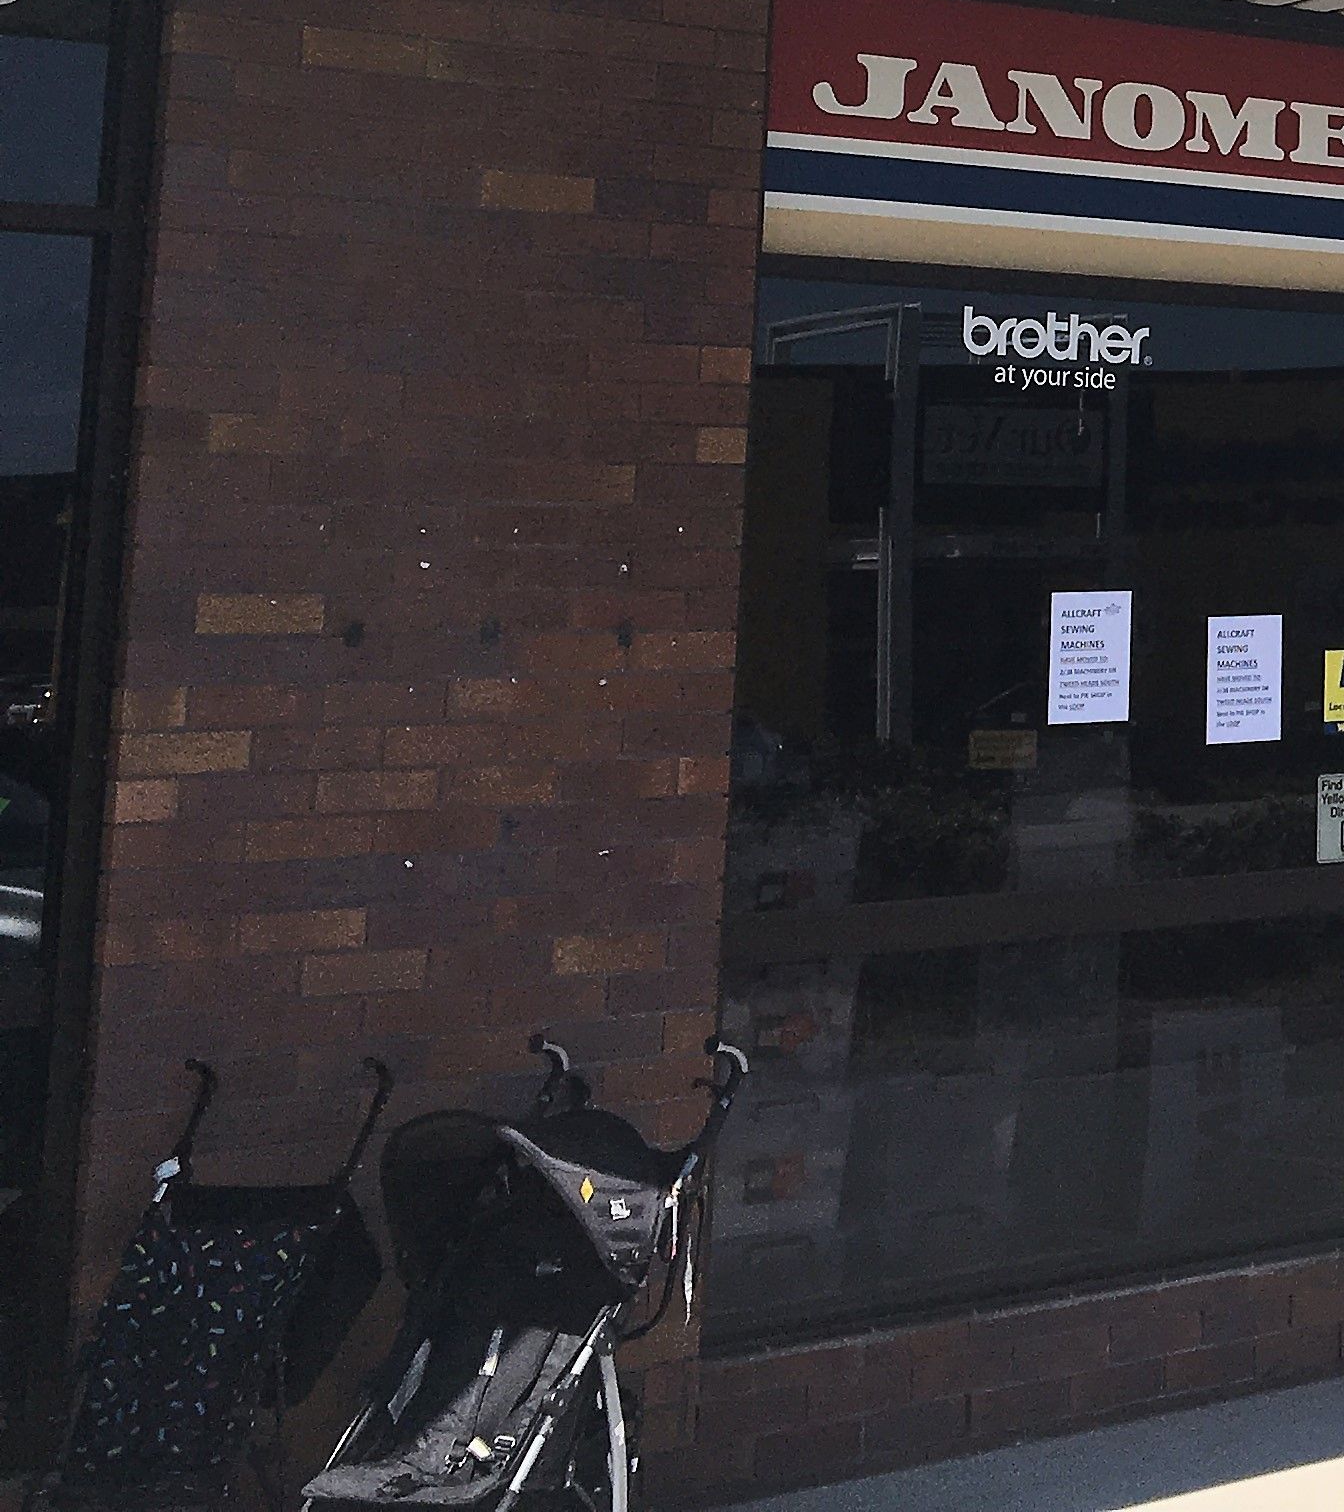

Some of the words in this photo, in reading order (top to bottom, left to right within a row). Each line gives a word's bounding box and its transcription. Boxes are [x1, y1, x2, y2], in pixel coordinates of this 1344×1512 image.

[962, 306, 1150, 365] brother
[994, 365, 1016, 384] at
[1022, 367, 1070, 390] your
[1074, 367, 1116, 389] side
[1061, 609, 1102, 618] ALLCRAFT
[1061, 624, 1095, 634] SEWING
[1216, 629, 1255, 639] ALLCRAFT
[1061, 640, 1105, 649] MACHINES
[1216, 644, 1249, 654] SEWING
[1216, 659, 1258, 668] MACHINES
[1321, 779, 1343, 791] Find
